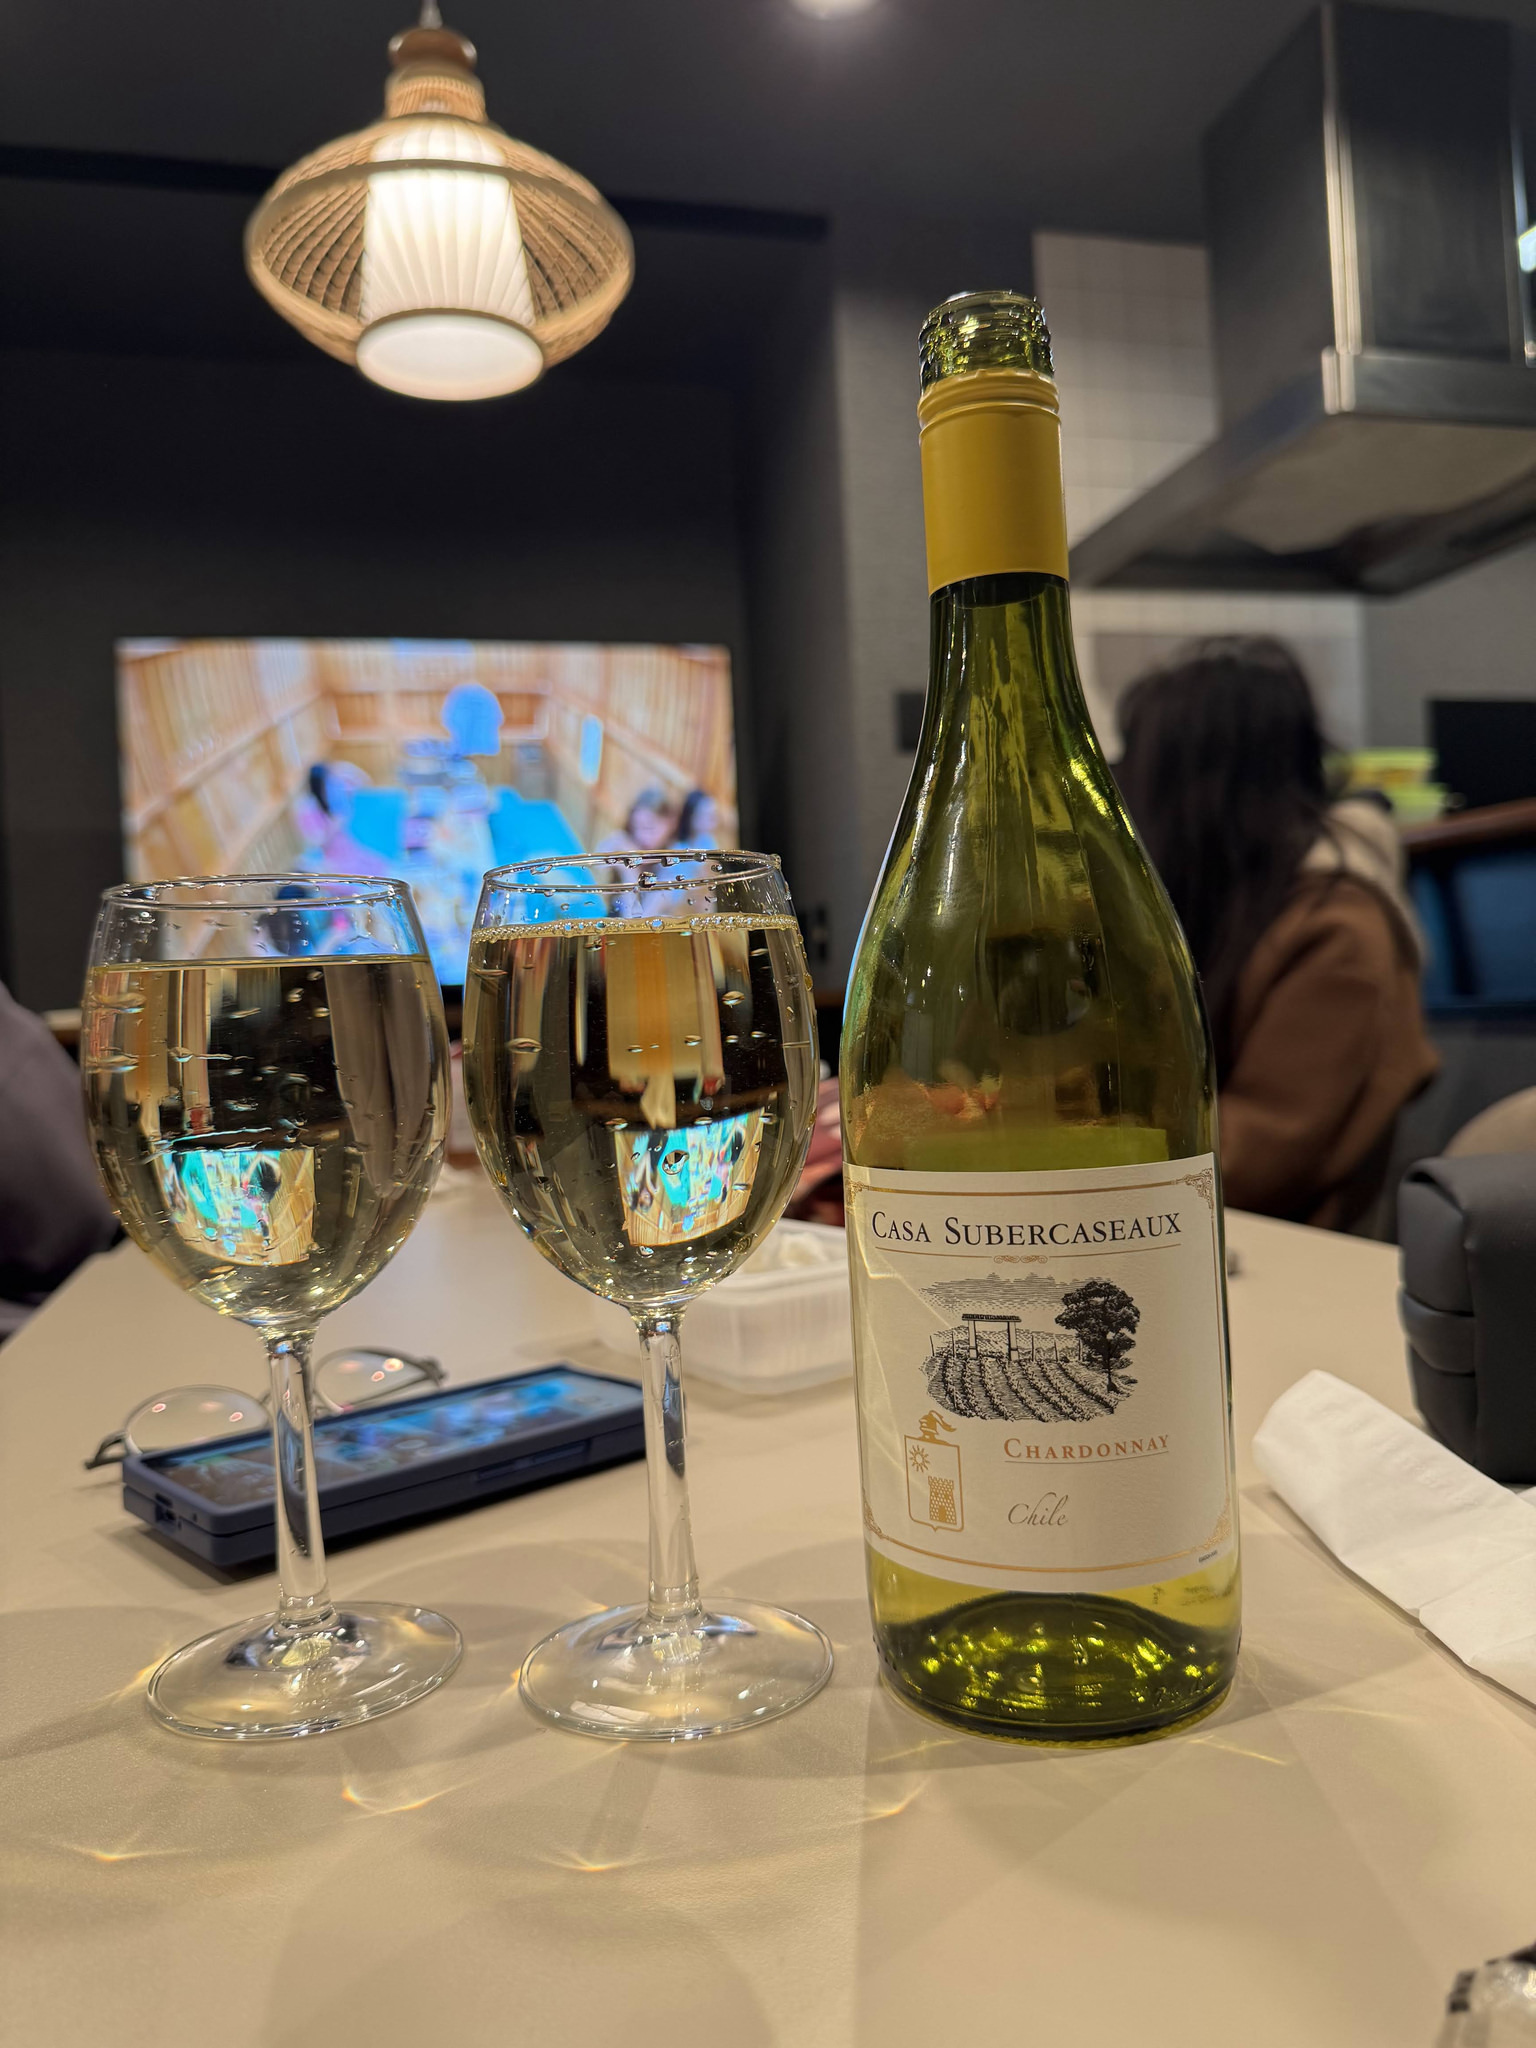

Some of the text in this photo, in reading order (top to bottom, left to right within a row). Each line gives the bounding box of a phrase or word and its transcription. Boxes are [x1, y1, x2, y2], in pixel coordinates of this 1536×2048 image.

[872, 1211, 1182, 1246] CASA SUBERCASEAUX
[1003, 1435, 1169, 1460] CHARDONNAY
[1008, 1492, 1069, 1527] Chile
